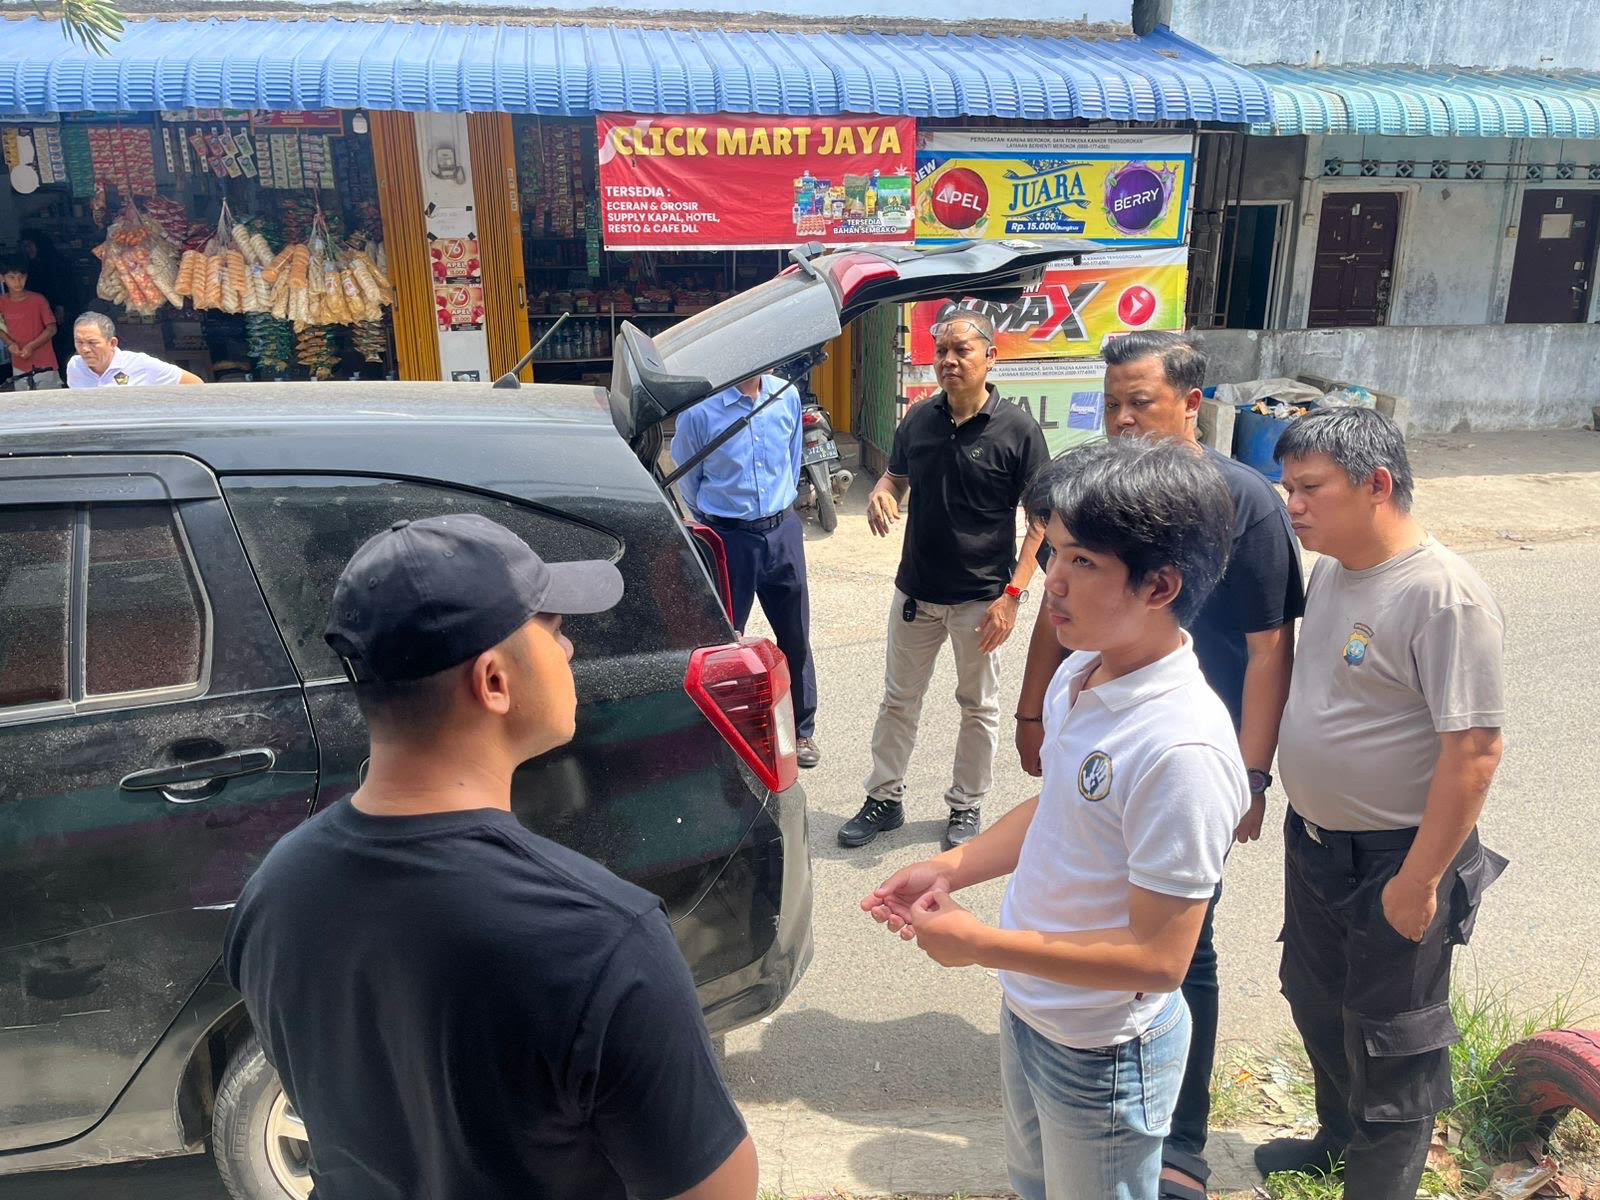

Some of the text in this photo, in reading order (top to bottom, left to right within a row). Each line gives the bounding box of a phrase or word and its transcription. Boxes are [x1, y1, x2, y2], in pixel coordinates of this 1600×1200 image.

[611, 125, 902, 158] CLICK MART JAYA
[914, 159, 937, 183] NEW
[604, 186, 665, 198] TERSEDIA
[1008, 171, 1086, 212] JUARA
[935, 188, 982, 212] APEL
[1114, 188, 1160, 212] BERRY
[606, 201, 699, 211] ECERAN & GROSIR
[607, 212, 721, 223] SUPPLY KAPAL, HOTEL,
[847, 218, 882, 226] TERSEDIA
[608, 223, 699, 233] RESTO & CAFE DLL
[833, 226, 897, 235] BAHAN SEMBAKO
[1010, 222, 1026, 233] Rp.
